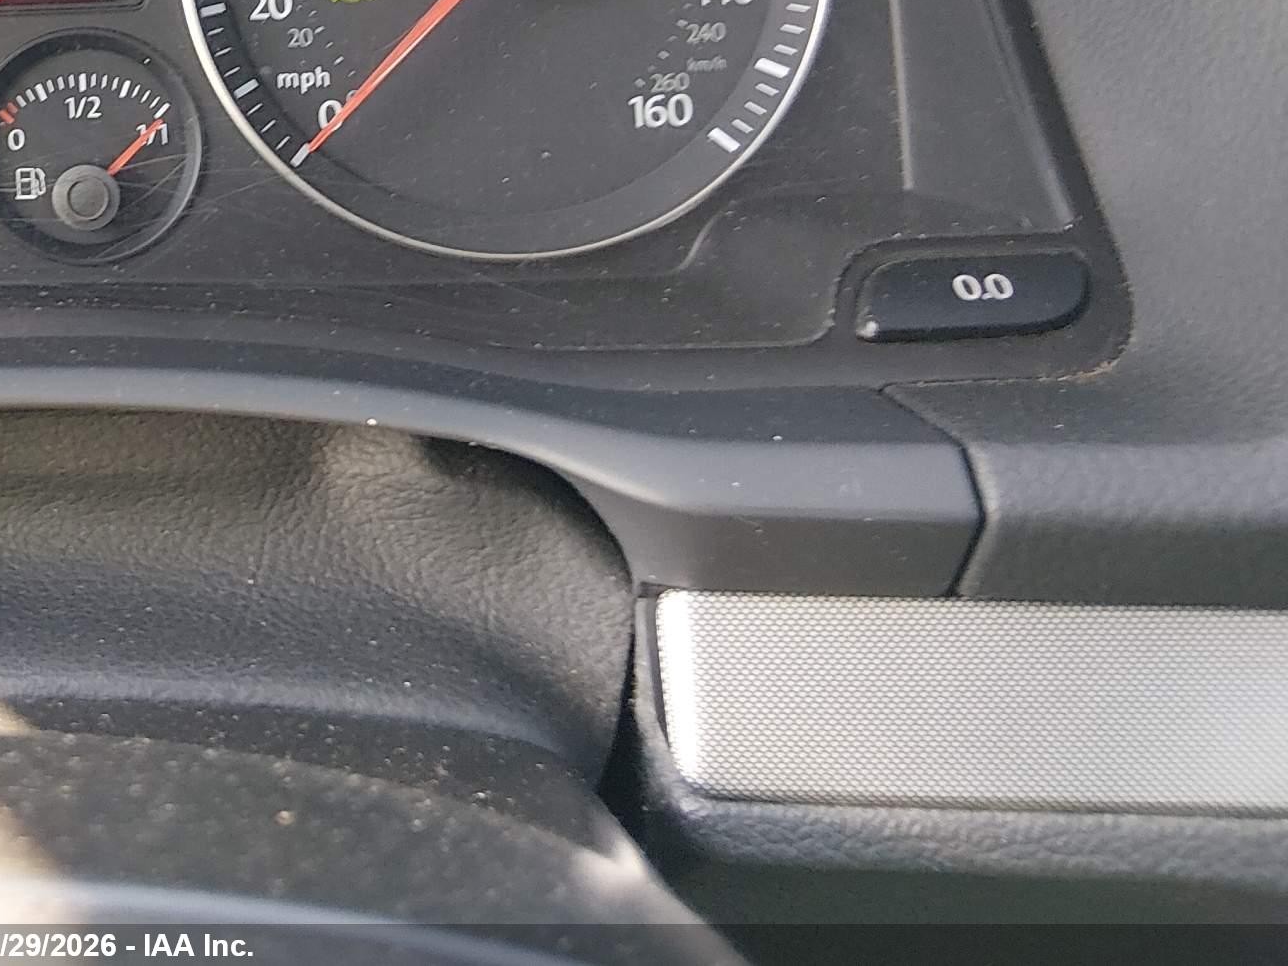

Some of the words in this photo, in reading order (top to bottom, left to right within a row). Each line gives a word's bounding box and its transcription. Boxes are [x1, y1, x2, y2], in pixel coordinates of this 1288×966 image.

[287, 27, 313, 48] 20
[686, 22, 726, 43] 240
[276, 66, 331, 94] mph
[650, 72, 690, 93] 260
[64, 96, 102, 119] 1/2
[318, 99, 343, 132] 0
[628, 93, 693, 129] 160
[8, 128, 25, 151] 0
[952, 273, 1013, 301] 0.0
